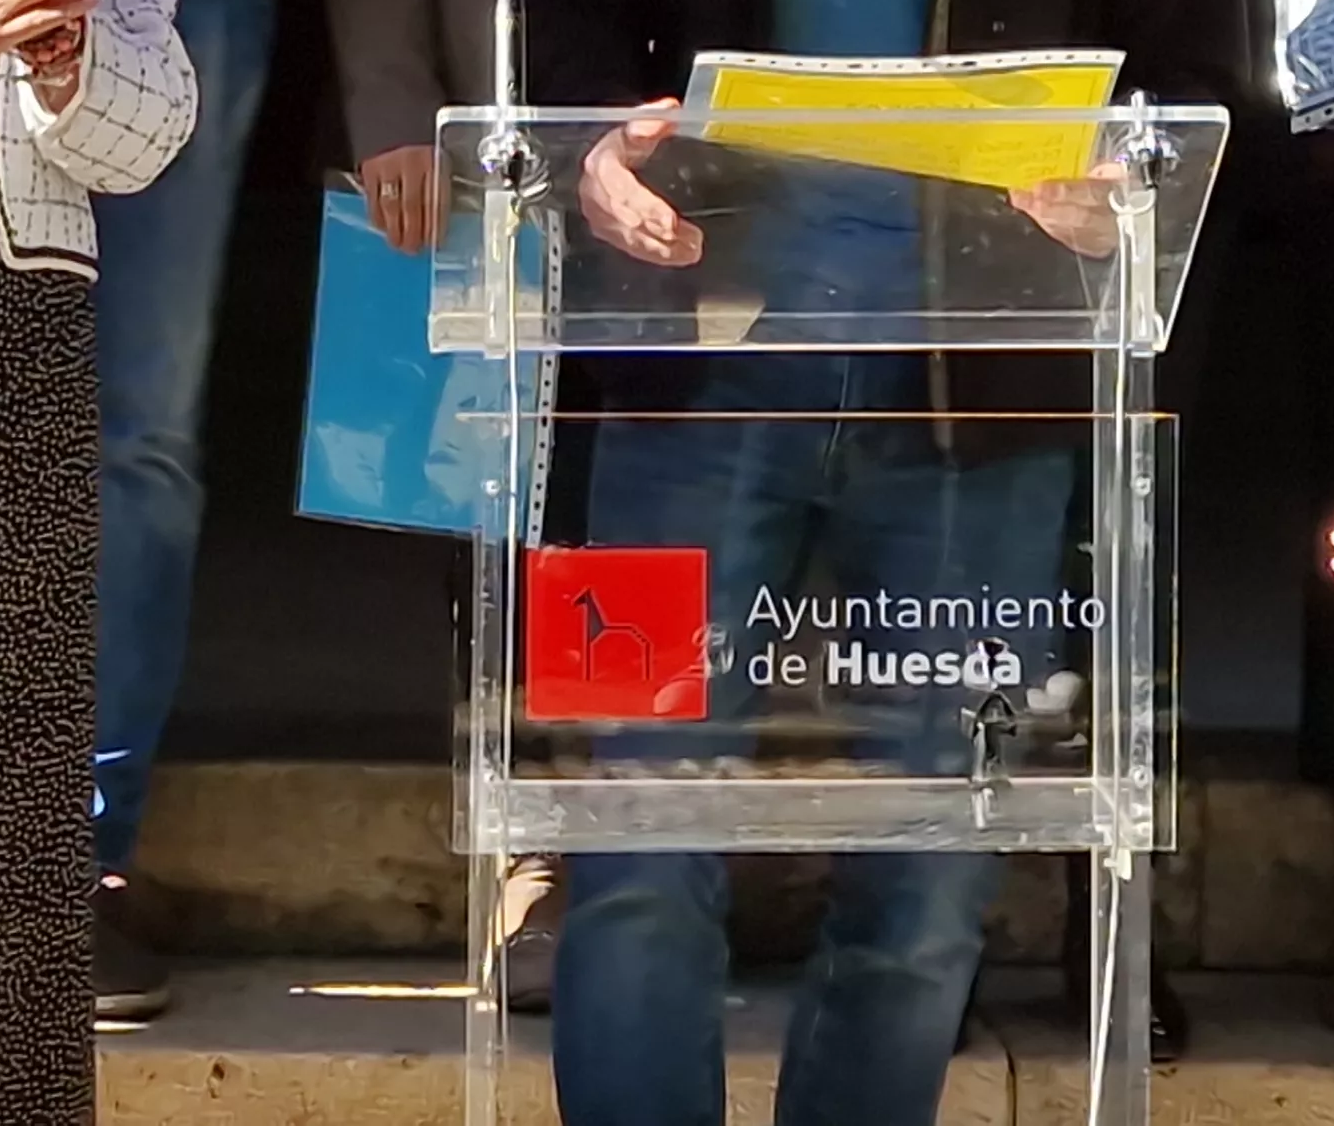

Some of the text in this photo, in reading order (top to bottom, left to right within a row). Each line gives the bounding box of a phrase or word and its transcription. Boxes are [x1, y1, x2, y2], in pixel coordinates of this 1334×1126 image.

[746, 584, 1107, 640] Ayuntamiento
[748, 641, 1021, 687] de Huesca
